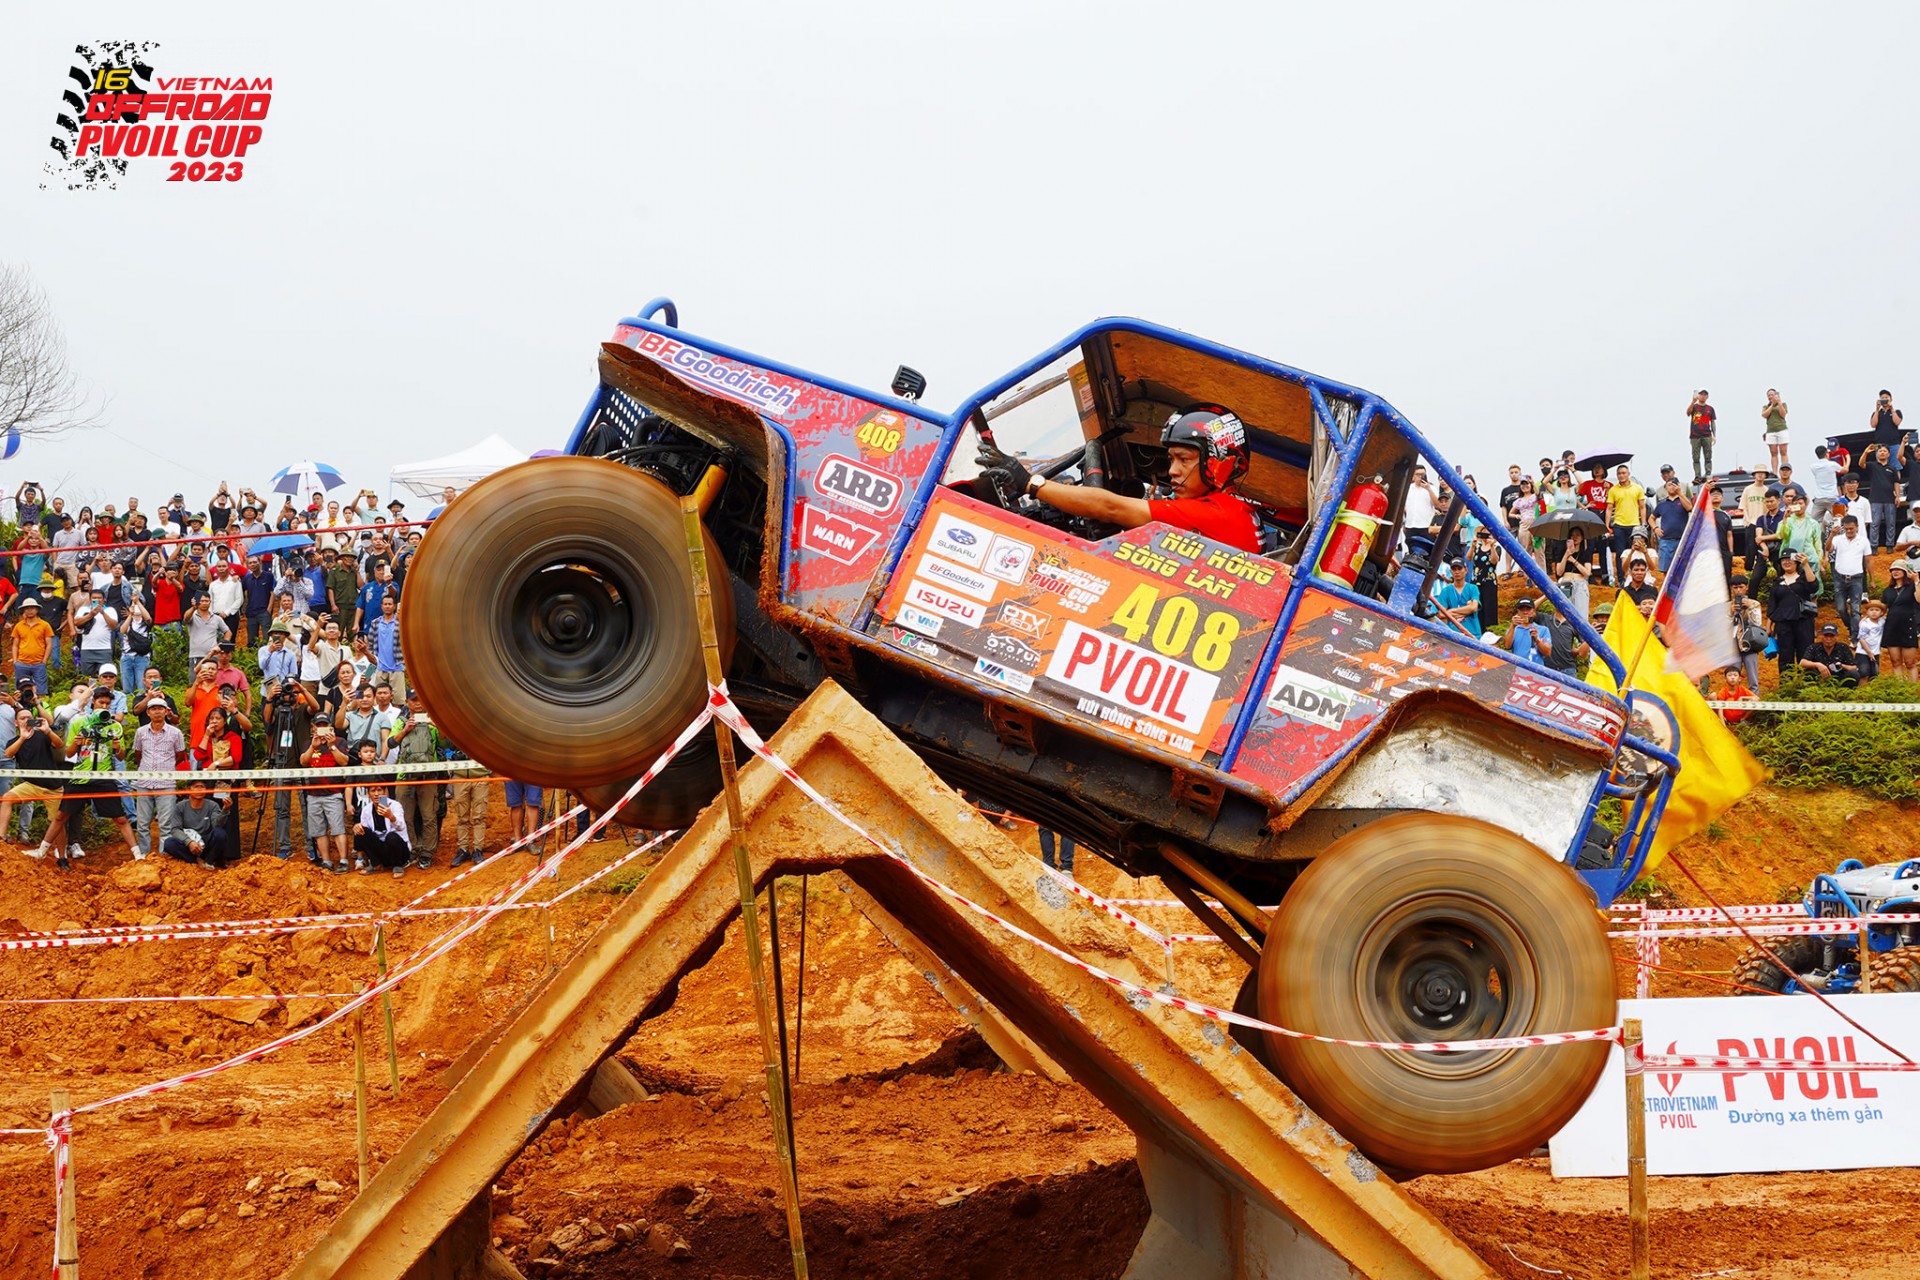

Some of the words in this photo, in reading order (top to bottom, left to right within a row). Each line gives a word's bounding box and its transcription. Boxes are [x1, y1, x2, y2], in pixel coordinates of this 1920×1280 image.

[638, 333, 795, 408] BFGoodrich
[857, 421, 901, 453] 408
[823, 464, 894, 508] ARB
[812, 524, 855, 551] WARN
[937, 540, 976, 559] SUBARU
[1160, 531, 1206, 560] NÚI
[929, 563, 985, 590] BFGoodrich
[1068, 566, 1111, 587] VIETNAM
[1113, 542, 1182, 578] SÔNG
[1184, 568, 1237, 599] LAM
[917, 589, 975, 618] ISUZU
[1029, 573, 1070, 597] PVOIL
[1068, 587, 1100, 607] CUP
[1057, 598, 1088, 614] 2023
[1112, 583, 1240, 672] 408
[1063, 632, 1190, 723] PVOIL
[1273, 684, 1347, 723] ADM
[1509, 686, 1620, 739] TURBO
[1168, 733, 1195, 753] LAM
[1717, 1036, 1879, 1102] PVOIL
[1659, 1114, 1698, 1129] PVOIL
[1728, 1108, 1785, 1126] Đường
[1790, 1110, 1808, 1123] xa
[1811, 1106, 1850, 1122] thêm
[1855, 1103, 1884, 1123] gần
